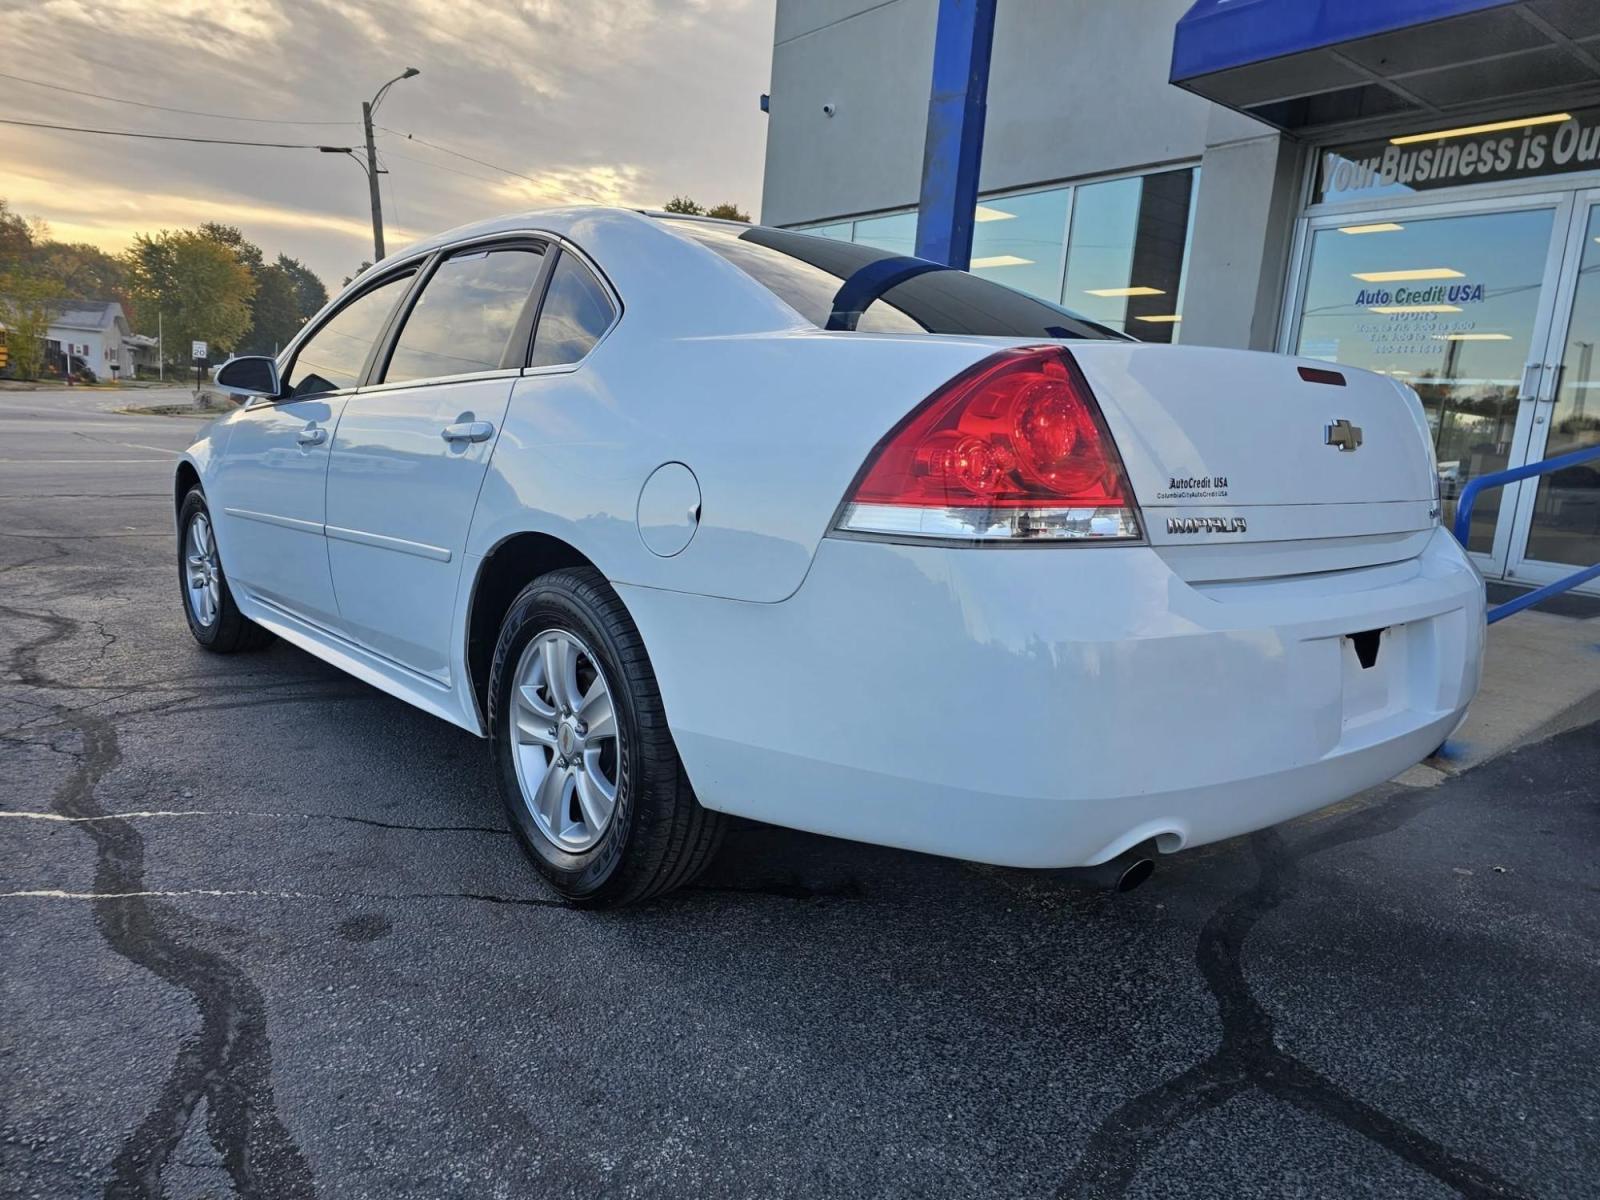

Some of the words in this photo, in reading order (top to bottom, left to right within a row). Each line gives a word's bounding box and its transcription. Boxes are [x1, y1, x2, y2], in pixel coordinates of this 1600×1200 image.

[1320, 152, 1383, 193] Your
[1382, 138, 1514, 186] Business
[1516, 127, 1548, 170] is
[1551, 119, 1600, 165] Ou
[1355, 289, 1390, 305] Auto
[1395, 286, 1443, 304] Credit
[1448, 284, 1482, 301] USA
[1168, 476, 1211, 489] AutoCredit
[1213, 477, 1228, 488] USA
[1167, 518, 1246, 533] IMPALA
